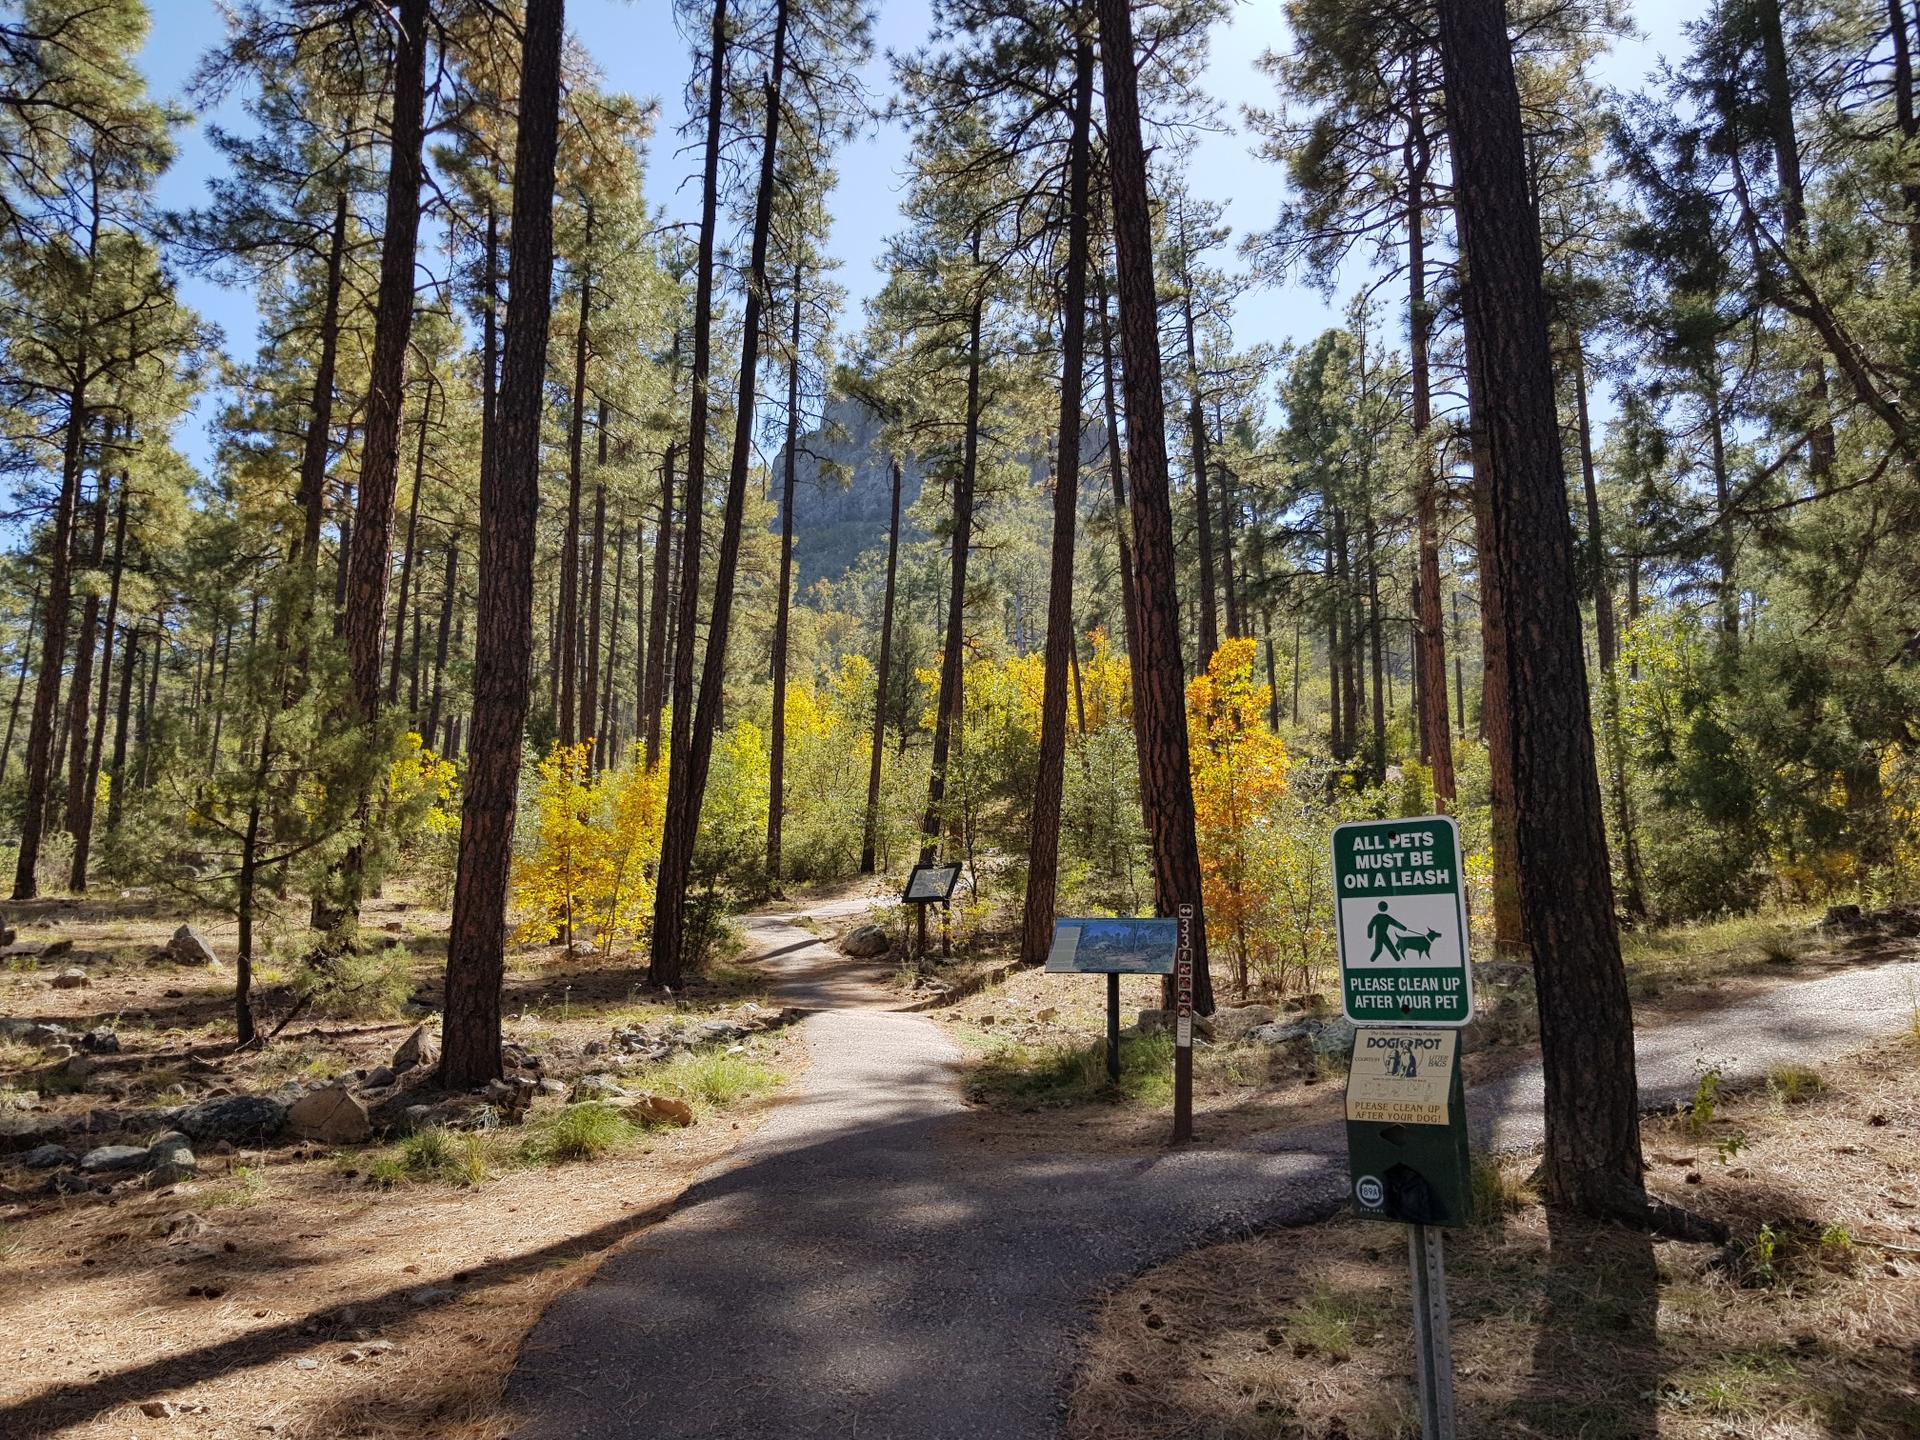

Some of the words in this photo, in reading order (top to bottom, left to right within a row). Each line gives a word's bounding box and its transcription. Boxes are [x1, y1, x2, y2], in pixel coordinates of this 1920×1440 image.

[1353, 835, 1384, 851] ALL
[1389, 831, 1434, 849] PETS
[1356, 852, 1404, 869] MUST
[1410, 851, 1434, 866] BE
[1344, 873, 1369, 888] ON
[1374, 872, 1388, 887] A
[1391, 869, 1450, 887] LEASH
[1350, 977, 1395, 992] PLEASE
[1398, 977, 1439, 991] CLEAN
[1443, 977, 1461, 990] UP
[1355, 995, 1393, 1009] AFTER
[1396, 995, 1432, 1009] YOUR
[1435, 995, 1459, 1009] PET
[1355, 1101, 1388, 1111] PLEASE
[1393, 1103, 1423, 1113] CLEAN
[1428, 1105, 1440, 1113] UP
[1355, 1111, 1384, 1120] AFTER
[1388, 1112, 1413, 1122] YOUR
[1417, 1113, 1441, 1123] DOG!
